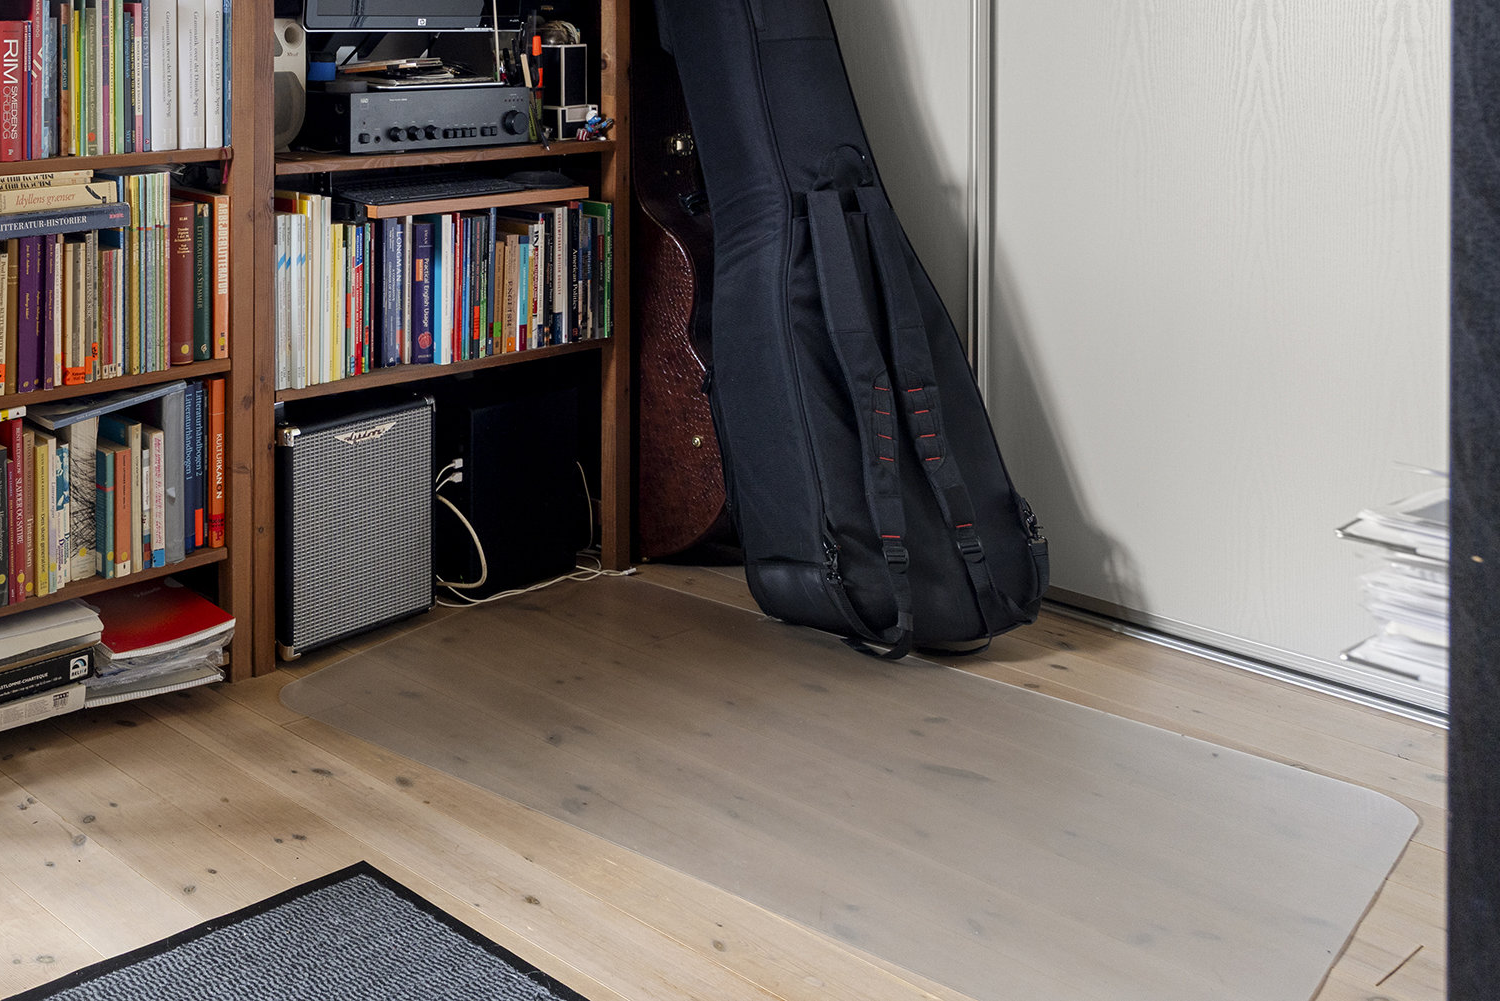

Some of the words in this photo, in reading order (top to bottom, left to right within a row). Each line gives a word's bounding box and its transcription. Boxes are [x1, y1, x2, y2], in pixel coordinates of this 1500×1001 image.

[3, 39, 19, 84] RIM
[15, 193, 43, 206] Idyllens
[215, 433, 223, 499] KULTURKANON
